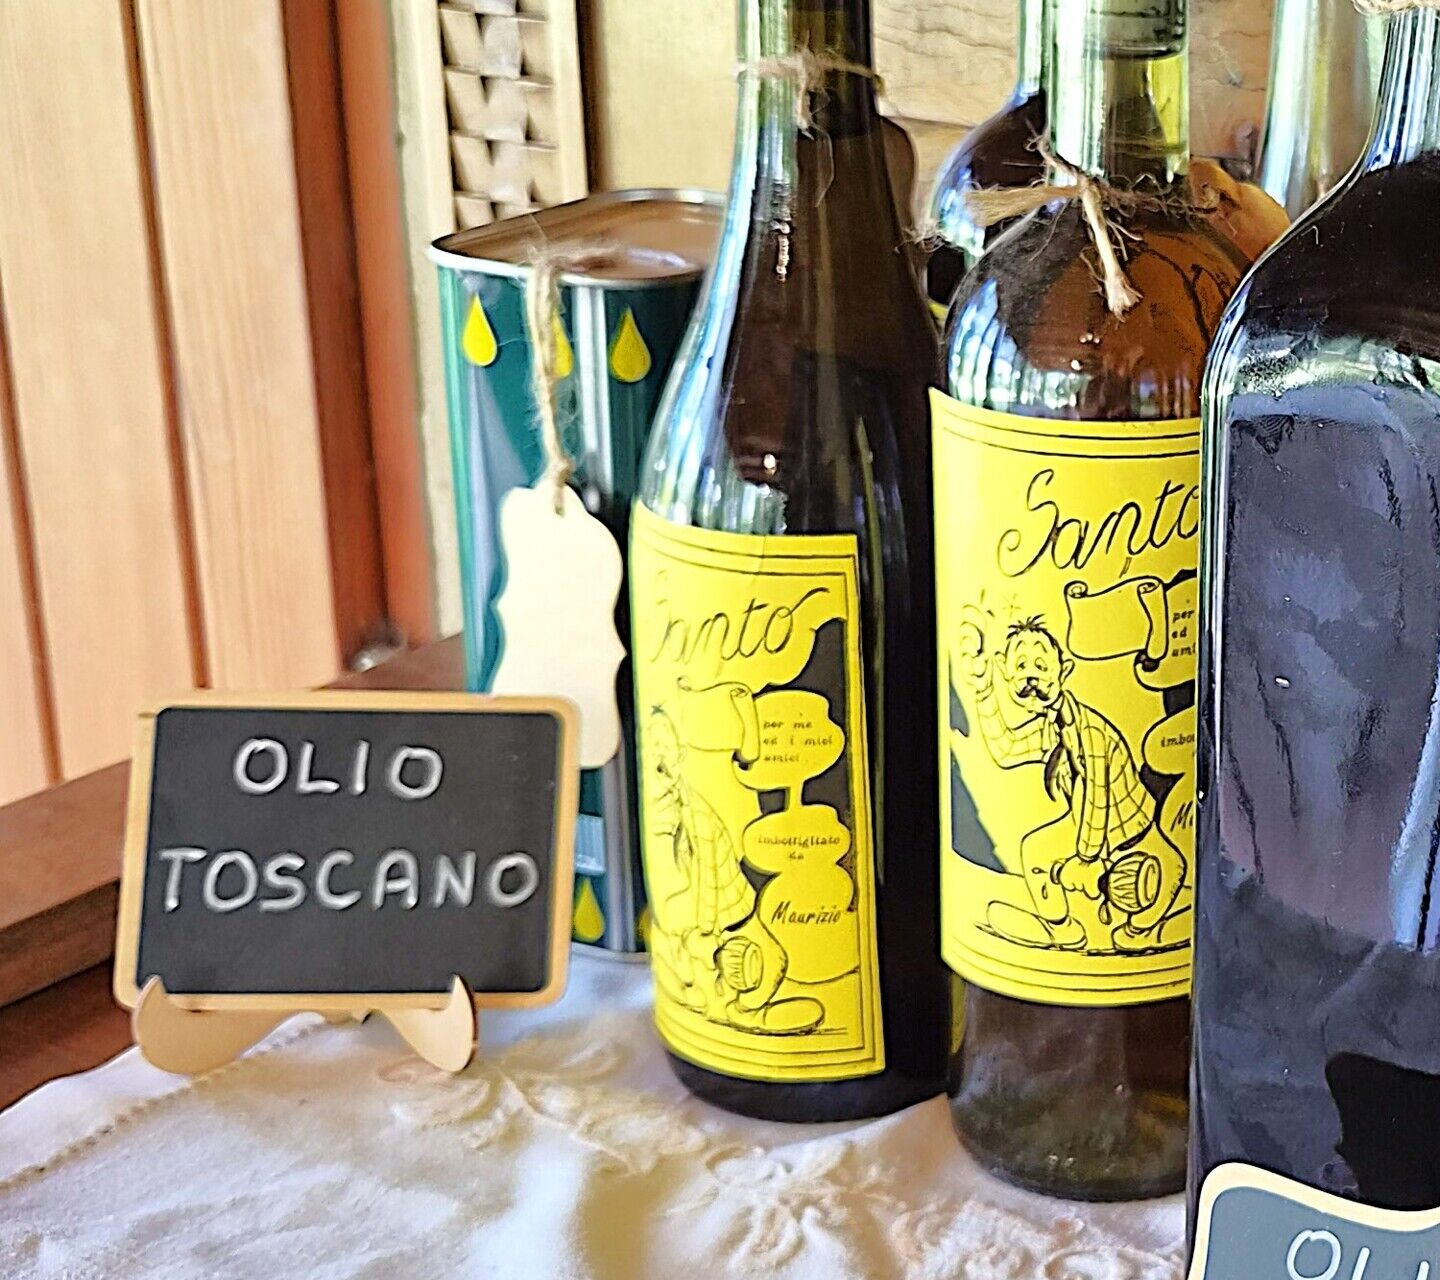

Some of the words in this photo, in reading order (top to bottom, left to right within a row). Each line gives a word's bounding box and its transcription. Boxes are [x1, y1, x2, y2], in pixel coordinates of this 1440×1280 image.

[1172, 609, 1195, 623] per
[1171, 626, 1188, 639] ed
[231, 736, 446, 800] OLIO
[158, 846, 540, 913] TOSCANO
[770, 900, 842, 925] Maurizio
